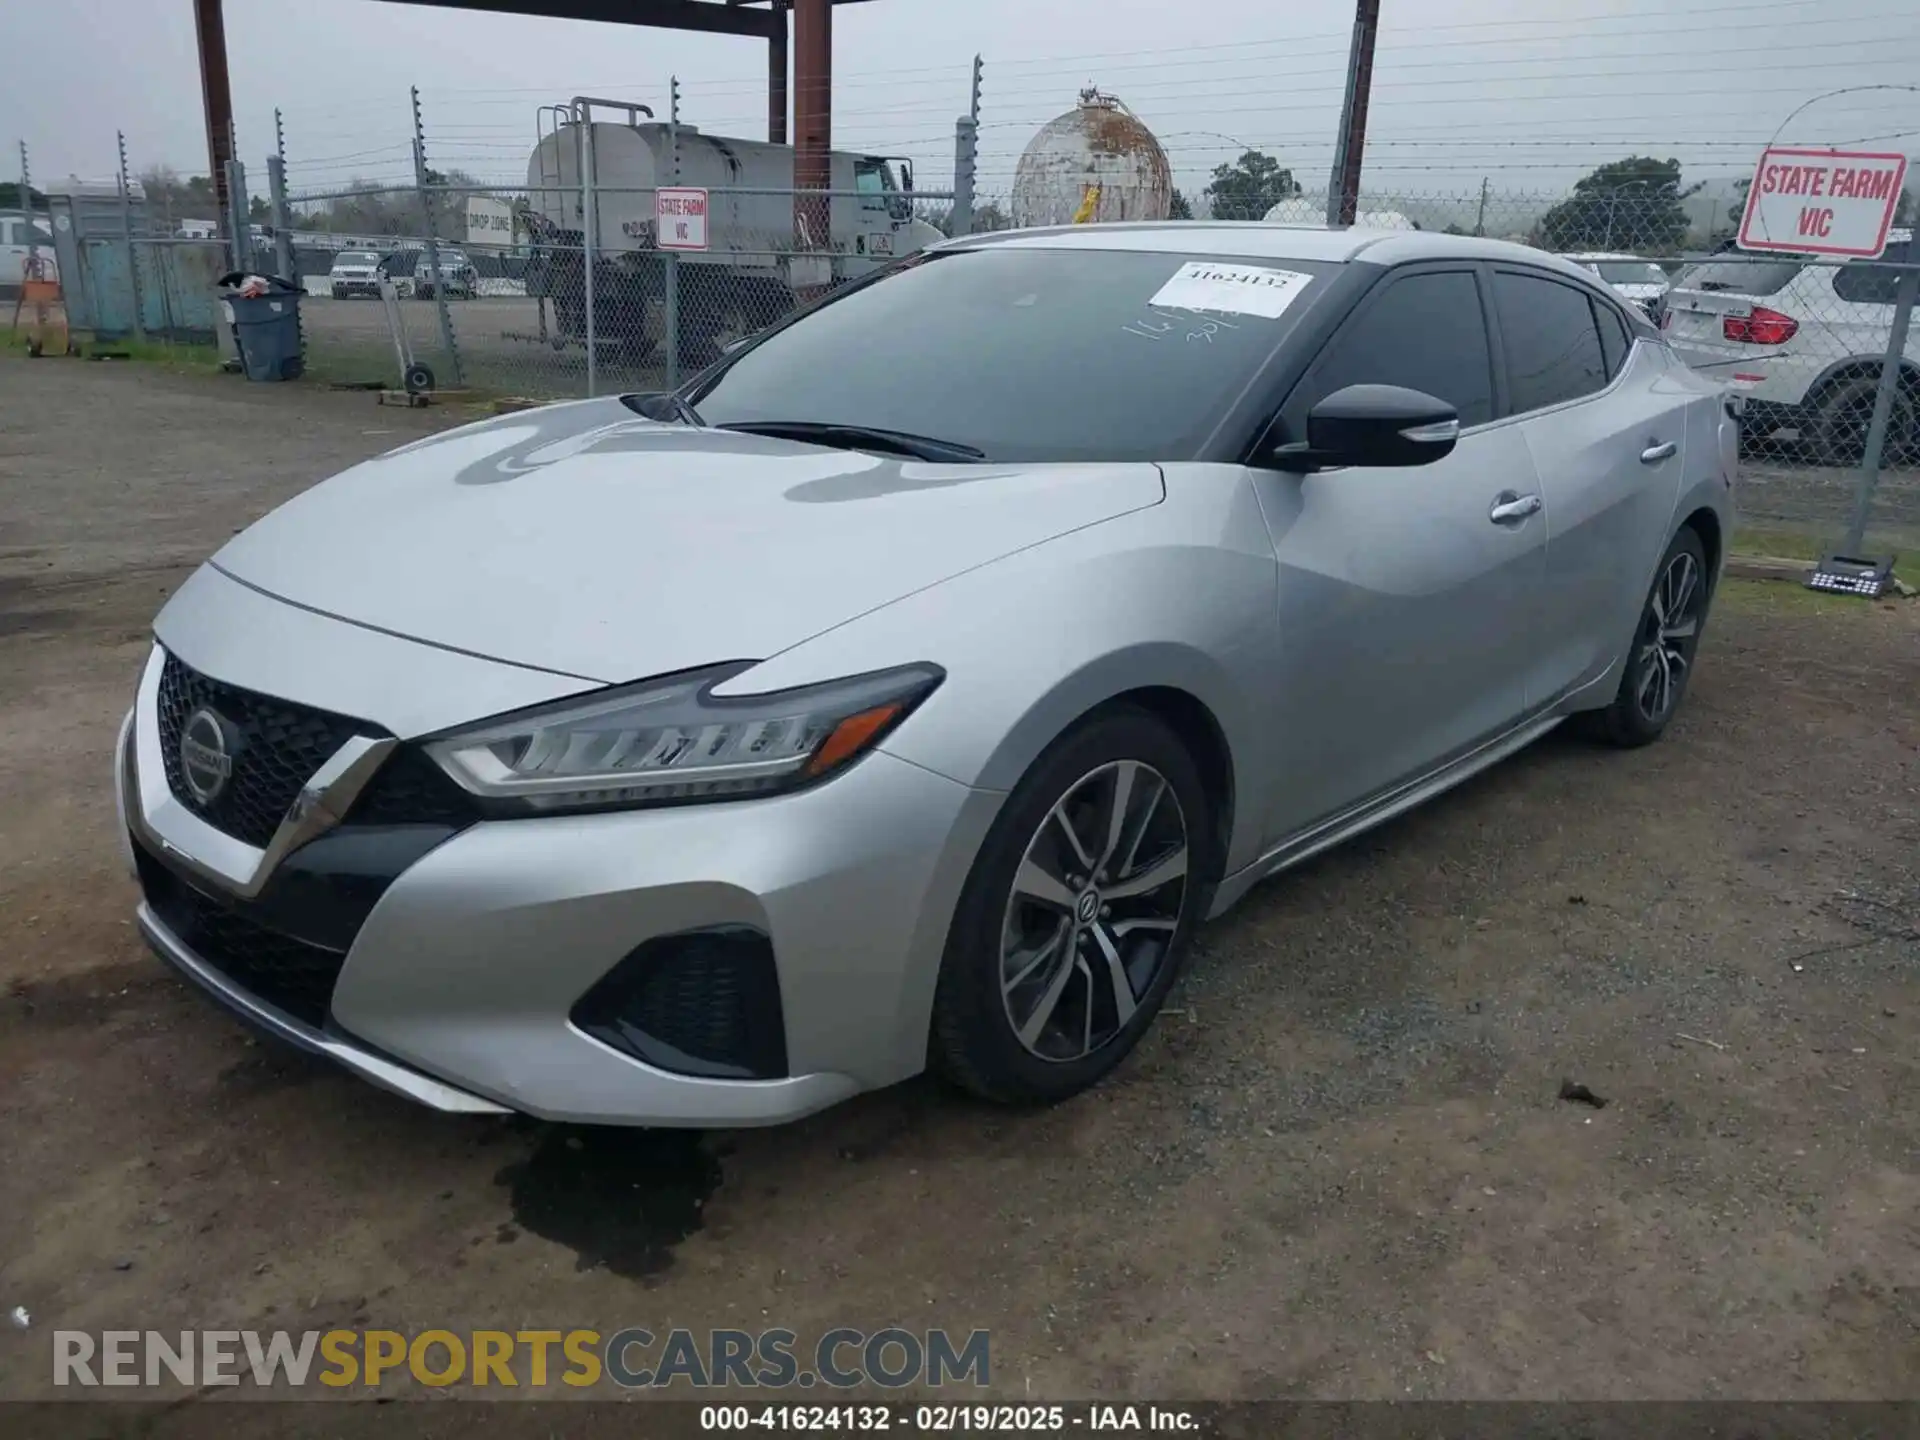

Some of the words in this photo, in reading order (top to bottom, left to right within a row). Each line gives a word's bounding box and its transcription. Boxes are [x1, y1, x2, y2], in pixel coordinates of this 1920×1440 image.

[1762, 164, 1828, 196] STATE
[1828, 168, 1895, 201] FARM
[659, 198, 682, 216] STATE
[682, 198, 705, 216] FARM
[469, 213, 490, 230] DROP
[490, 215, 510, 232] ZONE
[675, 221, 689, 241] VIC
[1797, 207, 1834, 238] VIC
[1190, 270, 1289, 289] 41624132
